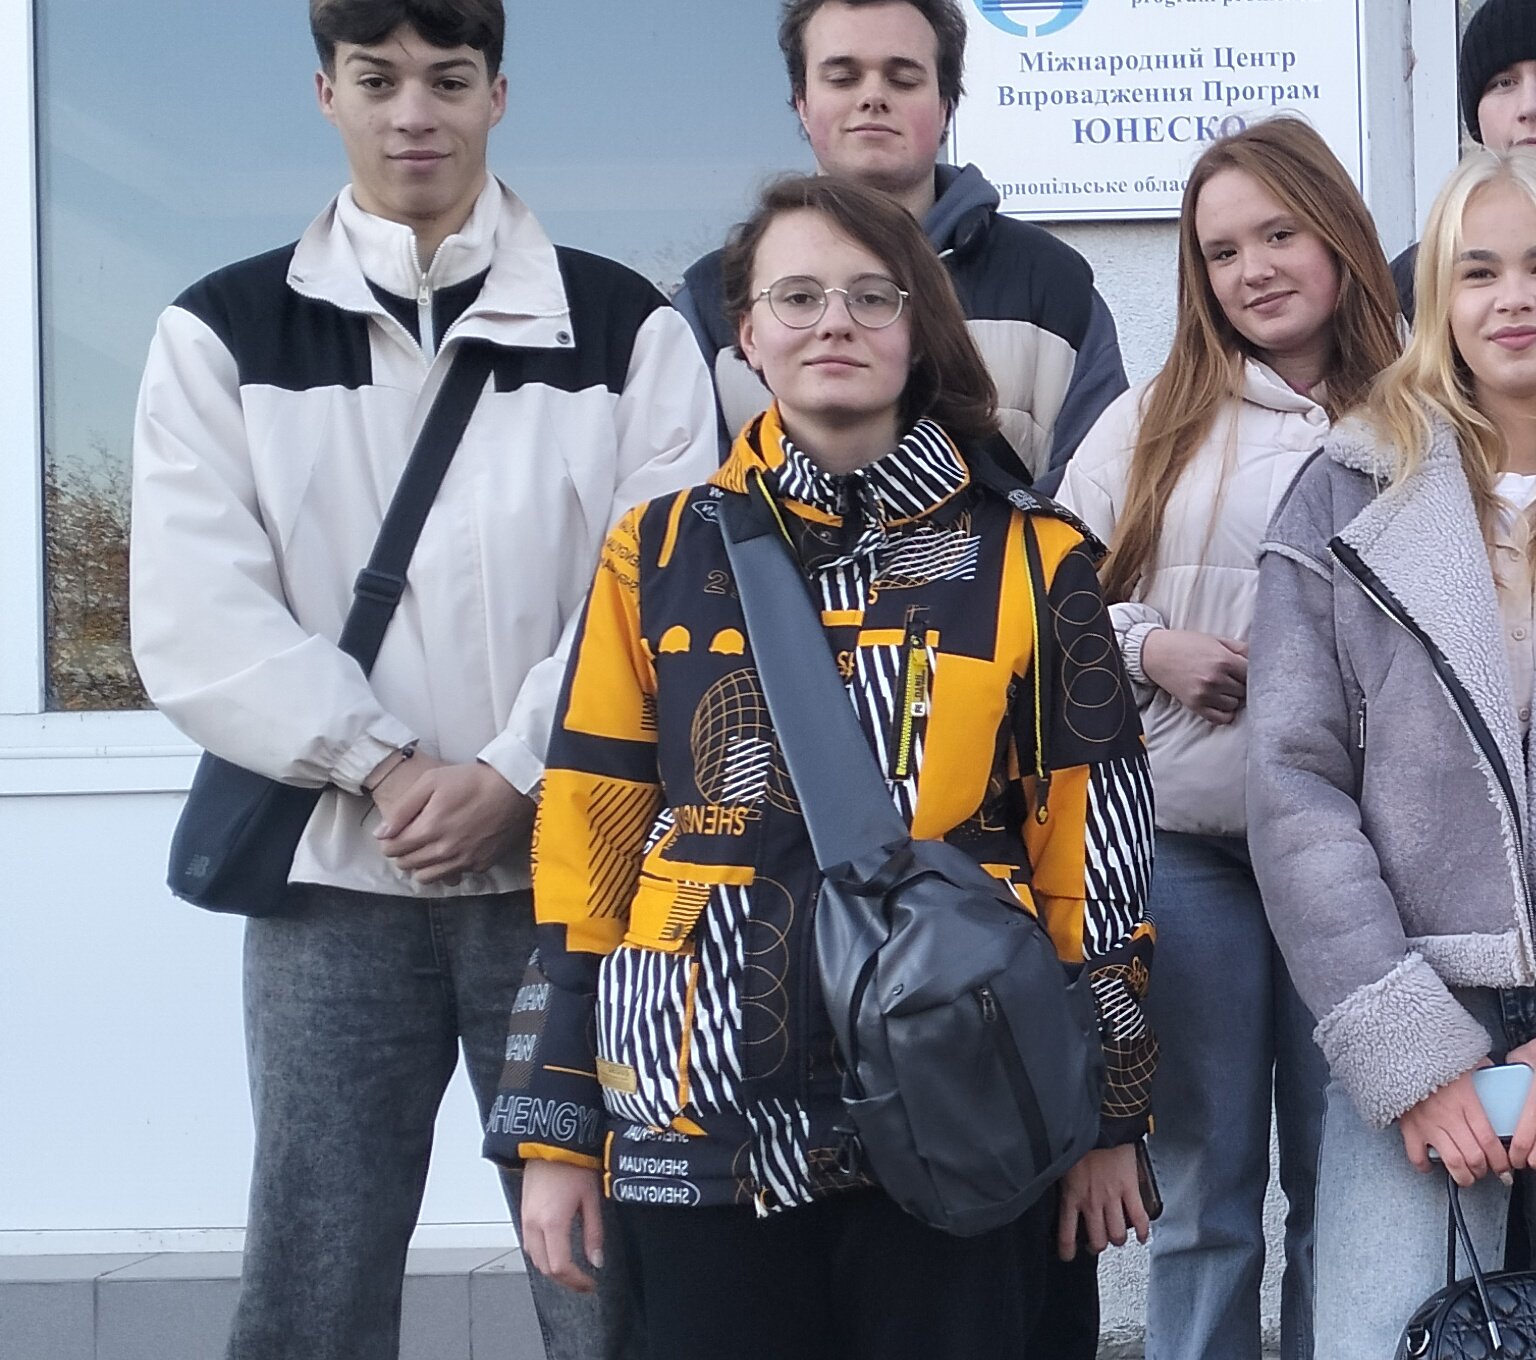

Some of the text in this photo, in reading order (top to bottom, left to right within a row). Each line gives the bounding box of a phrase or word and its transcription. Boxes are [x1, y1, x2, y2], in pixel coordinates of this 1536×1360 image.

[1019, 46, 1296, 76] Міжнародний Центр
[997, 80, 1321, 112] Впровадження Програм
[1072, 114, 1247, 144] ЮНЕСКО
[987, 175, 1188, 200] ернопільське облас
